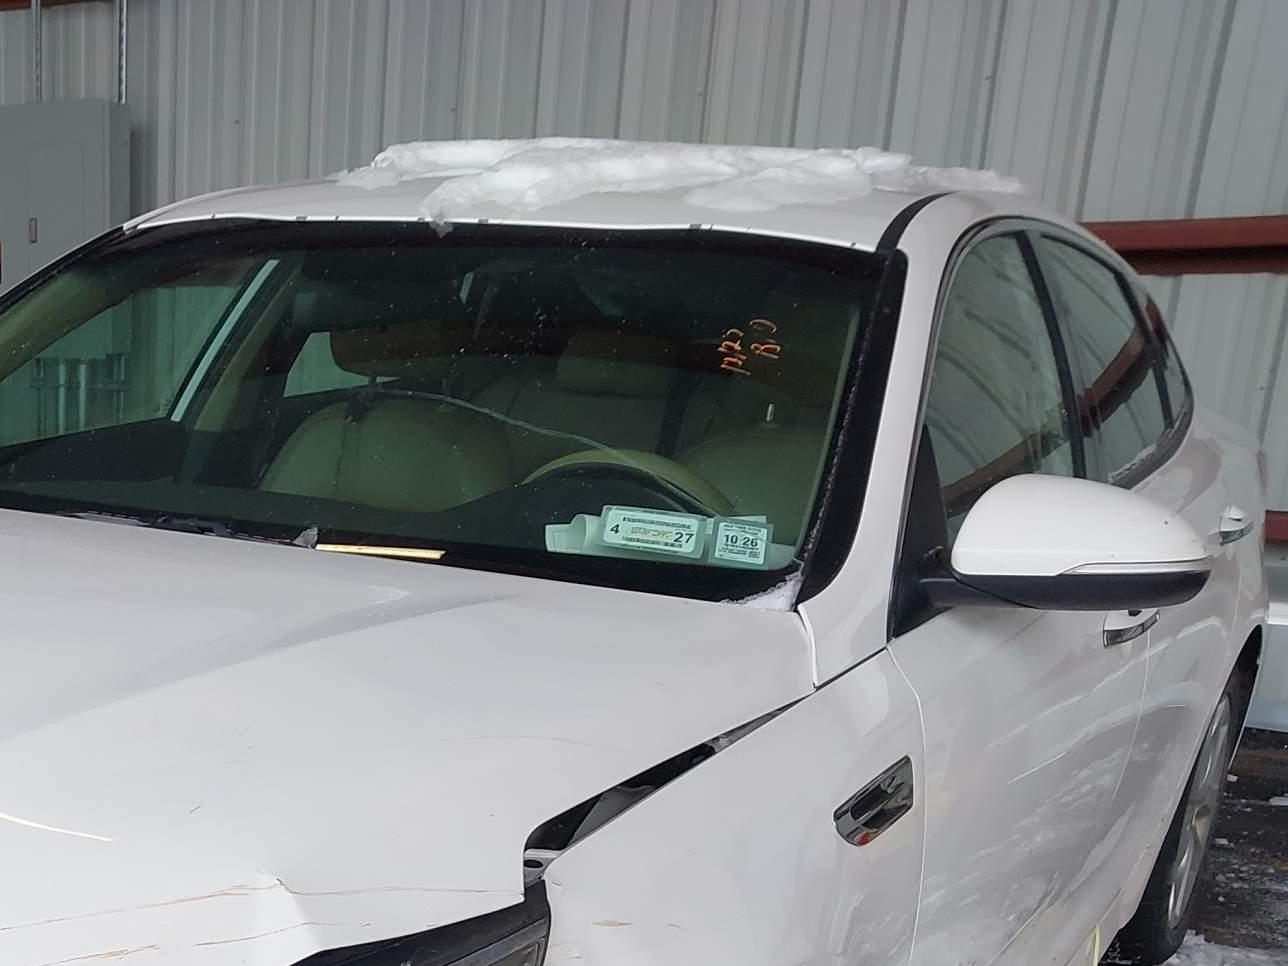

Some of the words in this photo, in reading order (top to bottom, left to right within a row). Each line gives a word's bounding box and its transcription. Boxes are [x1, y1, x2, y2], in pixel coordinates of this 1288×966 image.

[609, 523, 620, 534] 4
[673, 531, 695, 544] 27
[723, 534, 739, 544] 10
[742, 536, 759, 547] 26
